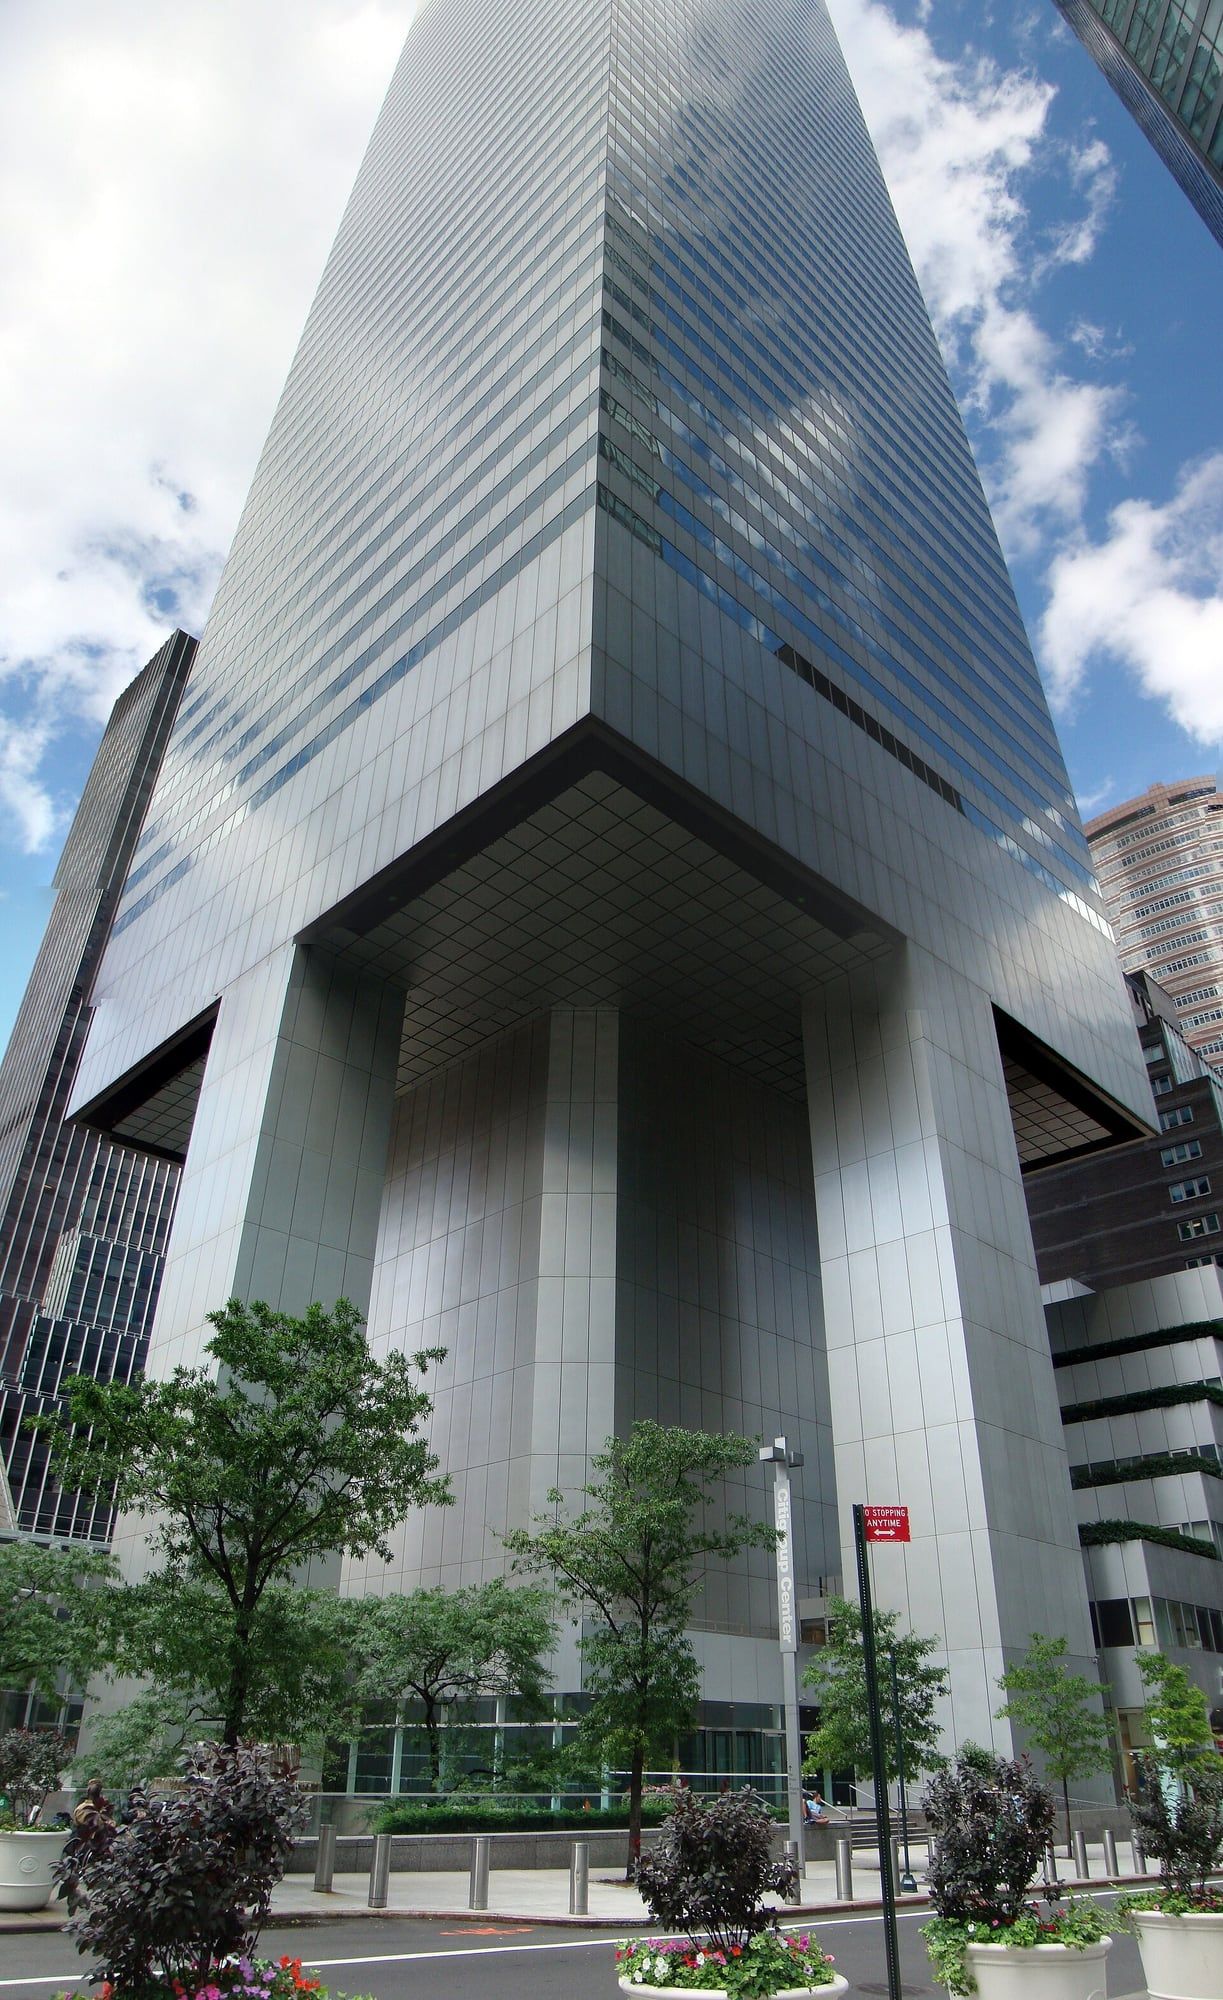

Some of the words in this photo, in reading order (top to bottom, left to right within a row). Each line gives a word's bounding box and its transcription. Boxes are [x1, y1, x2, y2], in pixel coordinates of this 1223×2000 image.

[864, 1509, 870, 1517] O
[872, 1509, 906, 1517] STOPPING
[866, 1519, 902, 1527] ANYTIME
[781, 1577, 793, 1643] Center
